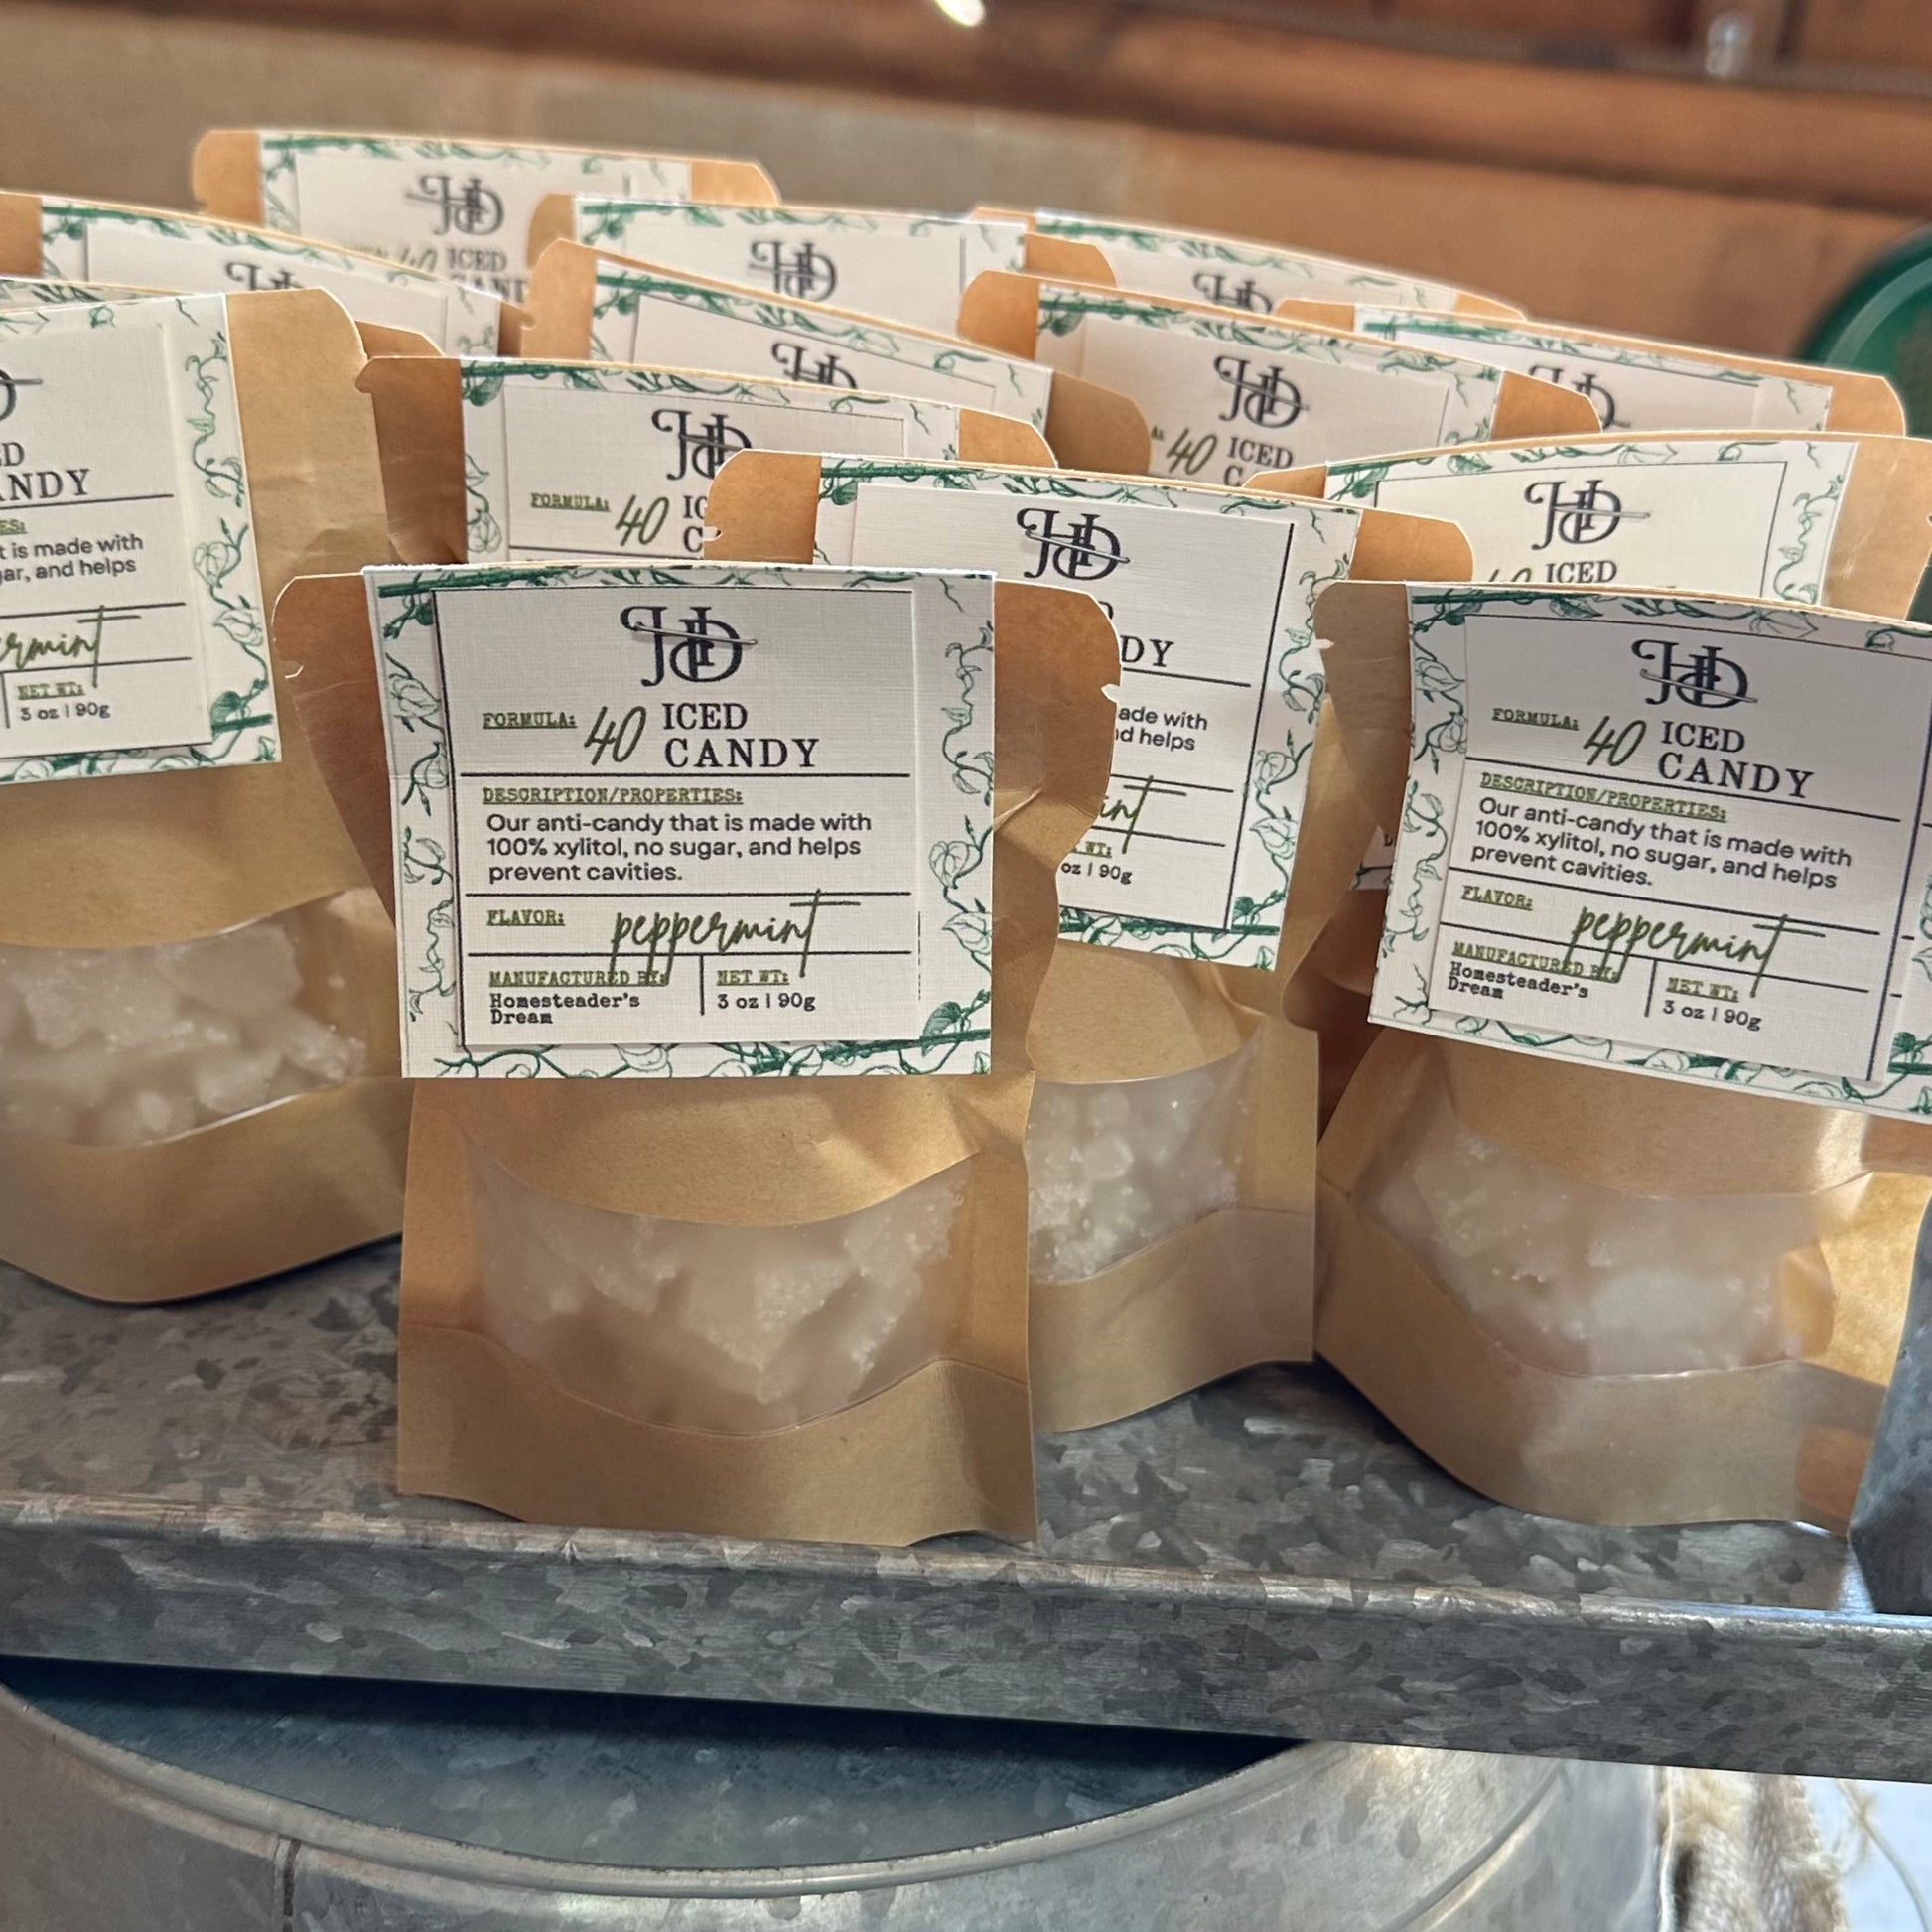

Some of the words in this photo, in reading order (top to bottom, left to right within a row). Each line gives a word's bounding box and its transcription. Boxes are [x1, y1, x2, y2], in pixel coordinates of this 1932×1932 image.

[448, 248, 507, 271] ICED
[1166, 427, 1218, 475] 40
[1227, 437, 1293, 469] ICED
[0, 468, 89, 501] NDY
[530, 492, 610, 512] FORMULA:
[615, 494, 670, 546] 40
[12, 542, 28, 559] is
[34, 537, 93, 557] made
[97, 533, 143, 552] with
[36, 561, 74, 579] and
[79, 558, 137, 577] helps
[1546, 559, 1617, 583] ICED
[20, 707, 32, 721] 3
[37, 708, 59, 720] oz
[75, 702, 110, 718] 90g
[1118, 706, 1158, 724] ade
[1163, 711, 1208, 730] with
[483, 711, 577, 729] FORMULA:
[583, 705, 647, 766] 40
[662, 702, 749, 731] ICED
[1139, 728, 1196, 752] helps
[1492, 708, 1580, 731] FORMULA:
[1583, 716, 1646, 767] 40
[1661, 720, 1745, 754] ICED
[663, 737, 820, 768] CANDY
[1658, 752, 1814, 798] CANDY
[482, 787, 744, 805] DESCRIPTION/PROPERTIES:
[1480, 772, 1727, 823] DESCRIPTION/PROPERTIES:
[486, 813, 531, 832] Our
[536, 812, 664, 836] anti-candy
[669, 813, 719, 832] that
[725, 813, 744, 832] is
[749, 813, 815, 832] made
[820, 813, 872, 831] with
[1479, 797, 1519, 818] Our
[1524, 807, 1645, 841] anti-candy
[1650, 823, 1698, 845] that
[1704, 829, 1722, 848] is
[1727, 836, 1794, 859] made
[1800, 846, 1852, 867] with
[487, 838, 548, 856] 100%
[554, 837, 629, 860] xylitol,
[634, 841, 664, 856] no
[669, 841, 743, 860] sugar,
[749, 837, 791, 856] and
[798, 837, 862, 859] helps
[1476, 820, 1530, 843] 100%
[1535, 831, 1605, 858] xylitol,
[1611, 844, 1639, 859] no
[1645, 848, 1717, 874] sugar,
[1723, 859, 1767, 878] and
[1773, 863, 1838, 889] helps
[488, 864, 581, 884] prevent
[586, 862, 683, 881] cavities.
[1060, 863, 1081, 873] oz
[1099, 864, 1133, 885] 90g
[1471, 845, 1556, 871] prevent
[1561, 861, 1653, 886] cavities.
[486, 909, 565, 927] FLAVOR:
[607, 888, 861, 987] peppermint
[1461, 885, 1533, 911] FLAVOR:
[1564, 906, 1826, 998] peppermint
[1451, 941, 1583, 978] MANUFACTURED
[488, 970, 630, 987] MANUFACTURED
[716, 970, 753, 985] NET
[1448, 977, 1503, 999] Dream
[1449, 961, 1588, 999] Homesteader's
[1666, 977, 1703, 998] NET
[490, 993, 640, 1009] Homesteader's
[717, 993, 729, 1009] 3
[736, 995, 759, 1009] oz
[777, 993, 815, 1012] 90g
[490, 1011, 553, 1025] Dream
[1663, 1000, 1674, 1015] 3
[1682, 1005, 1704, 1019] oz
[1724, 1010, 1762, 1032] 90g
